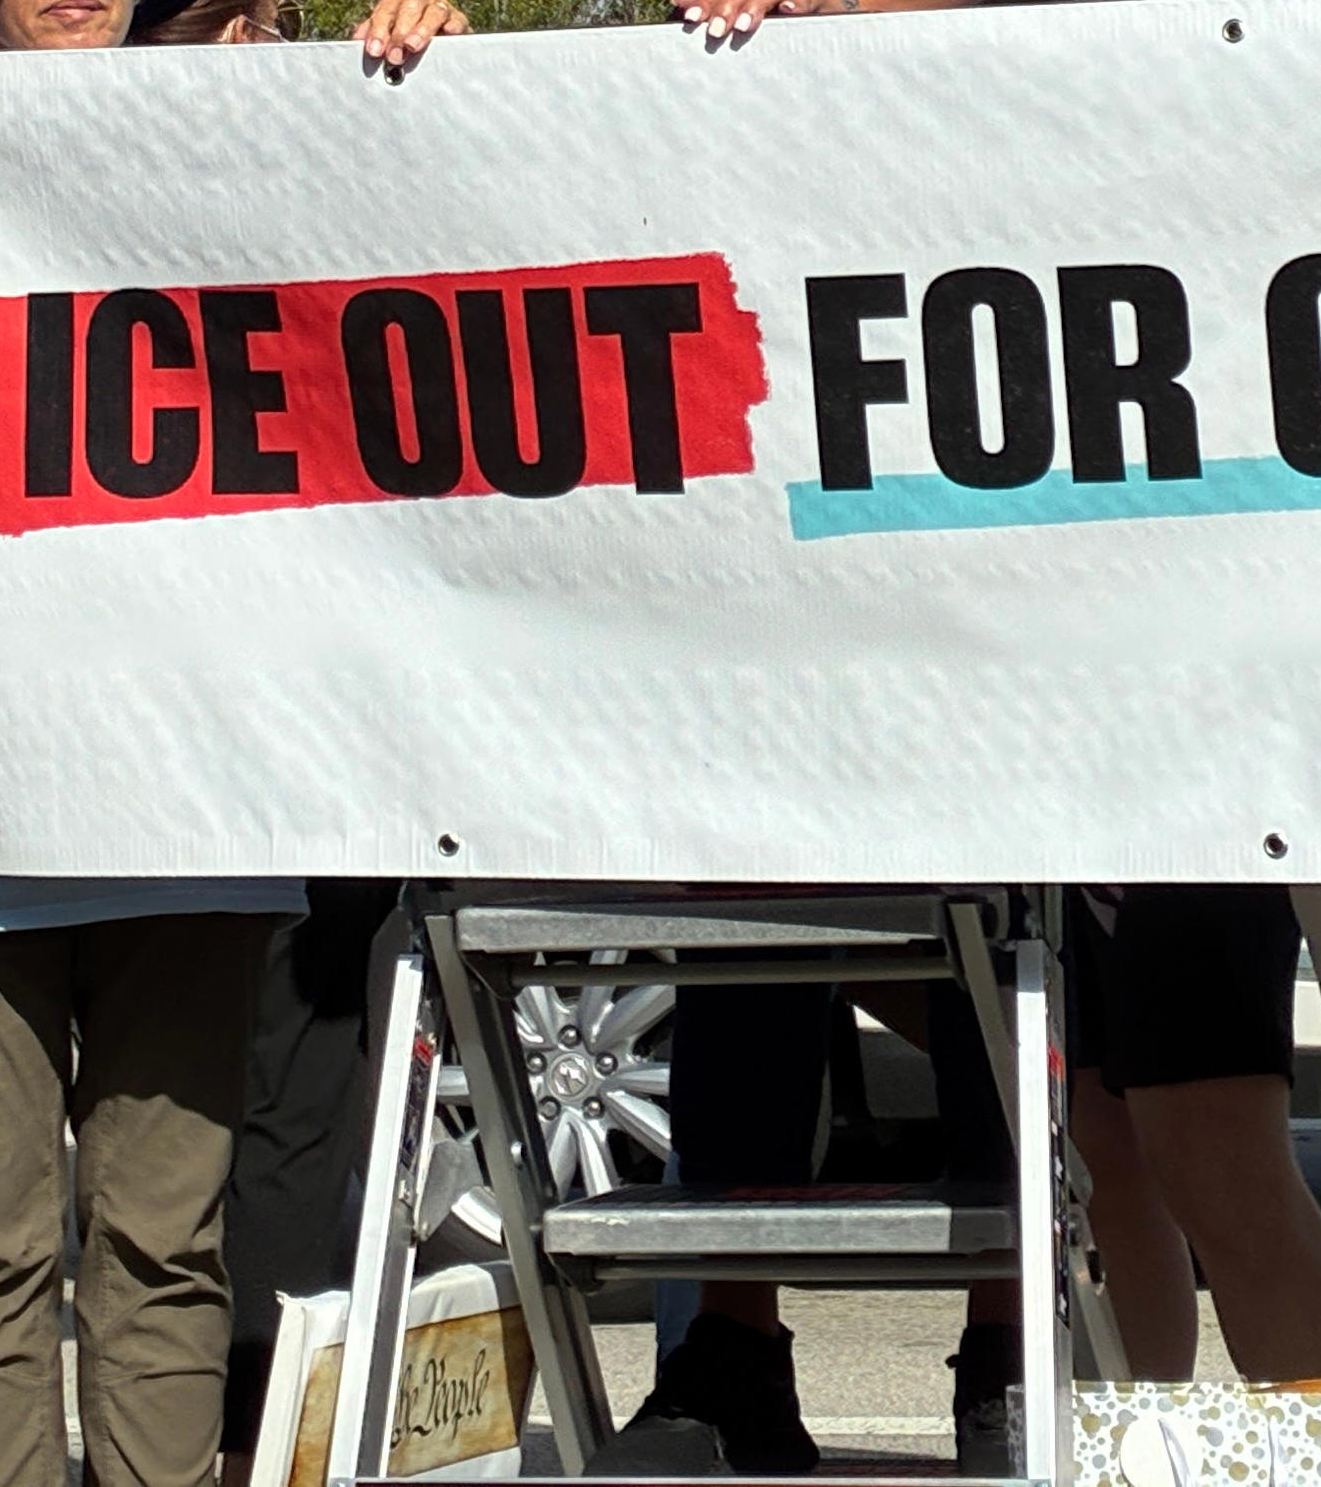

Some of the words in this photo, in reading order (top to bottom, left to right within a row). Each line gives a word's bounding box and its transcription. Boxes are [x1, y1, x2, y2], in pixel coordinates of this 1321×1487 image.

[25, 286, 300, 499] ICE
[340, 282, 704, 500] OUT
[804, 264, 1204, 491] FOR
